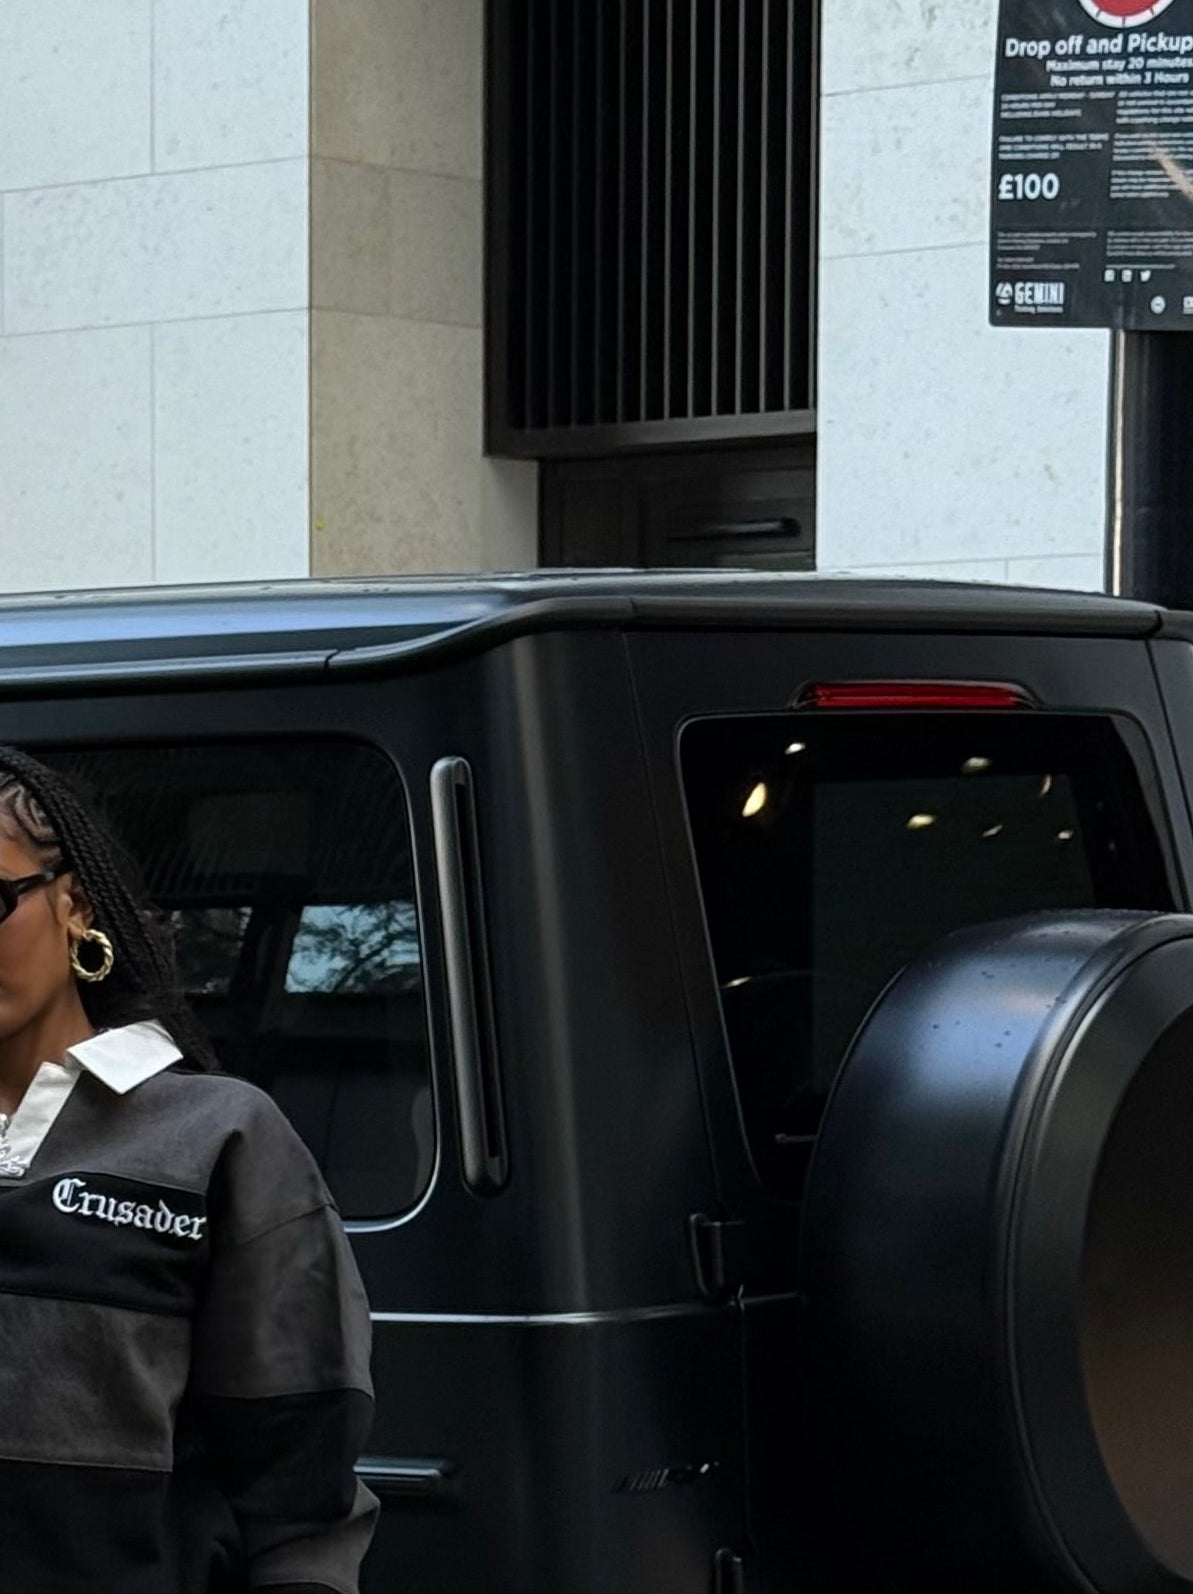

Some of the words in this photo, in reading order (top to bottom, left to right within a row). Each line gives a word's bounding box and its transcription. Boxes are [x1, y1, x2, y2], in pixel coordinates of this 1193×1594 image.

[1005, 38, 1051, 59] Drop
[1054, 35, 1083, 55] off
[1086, 33, 1123, 53] and
[1127, 32, 1193, 54] Pickup
[1050, 75, 1067, 87] No
[1068, 74, 1104, 87] return
[1106, 73, 1142, 85] within
[998, 173, 1060, 200] £100
[1014, 282, 1065, 305] GEMINI
[52, 1178, 207, 1241] Crusader
